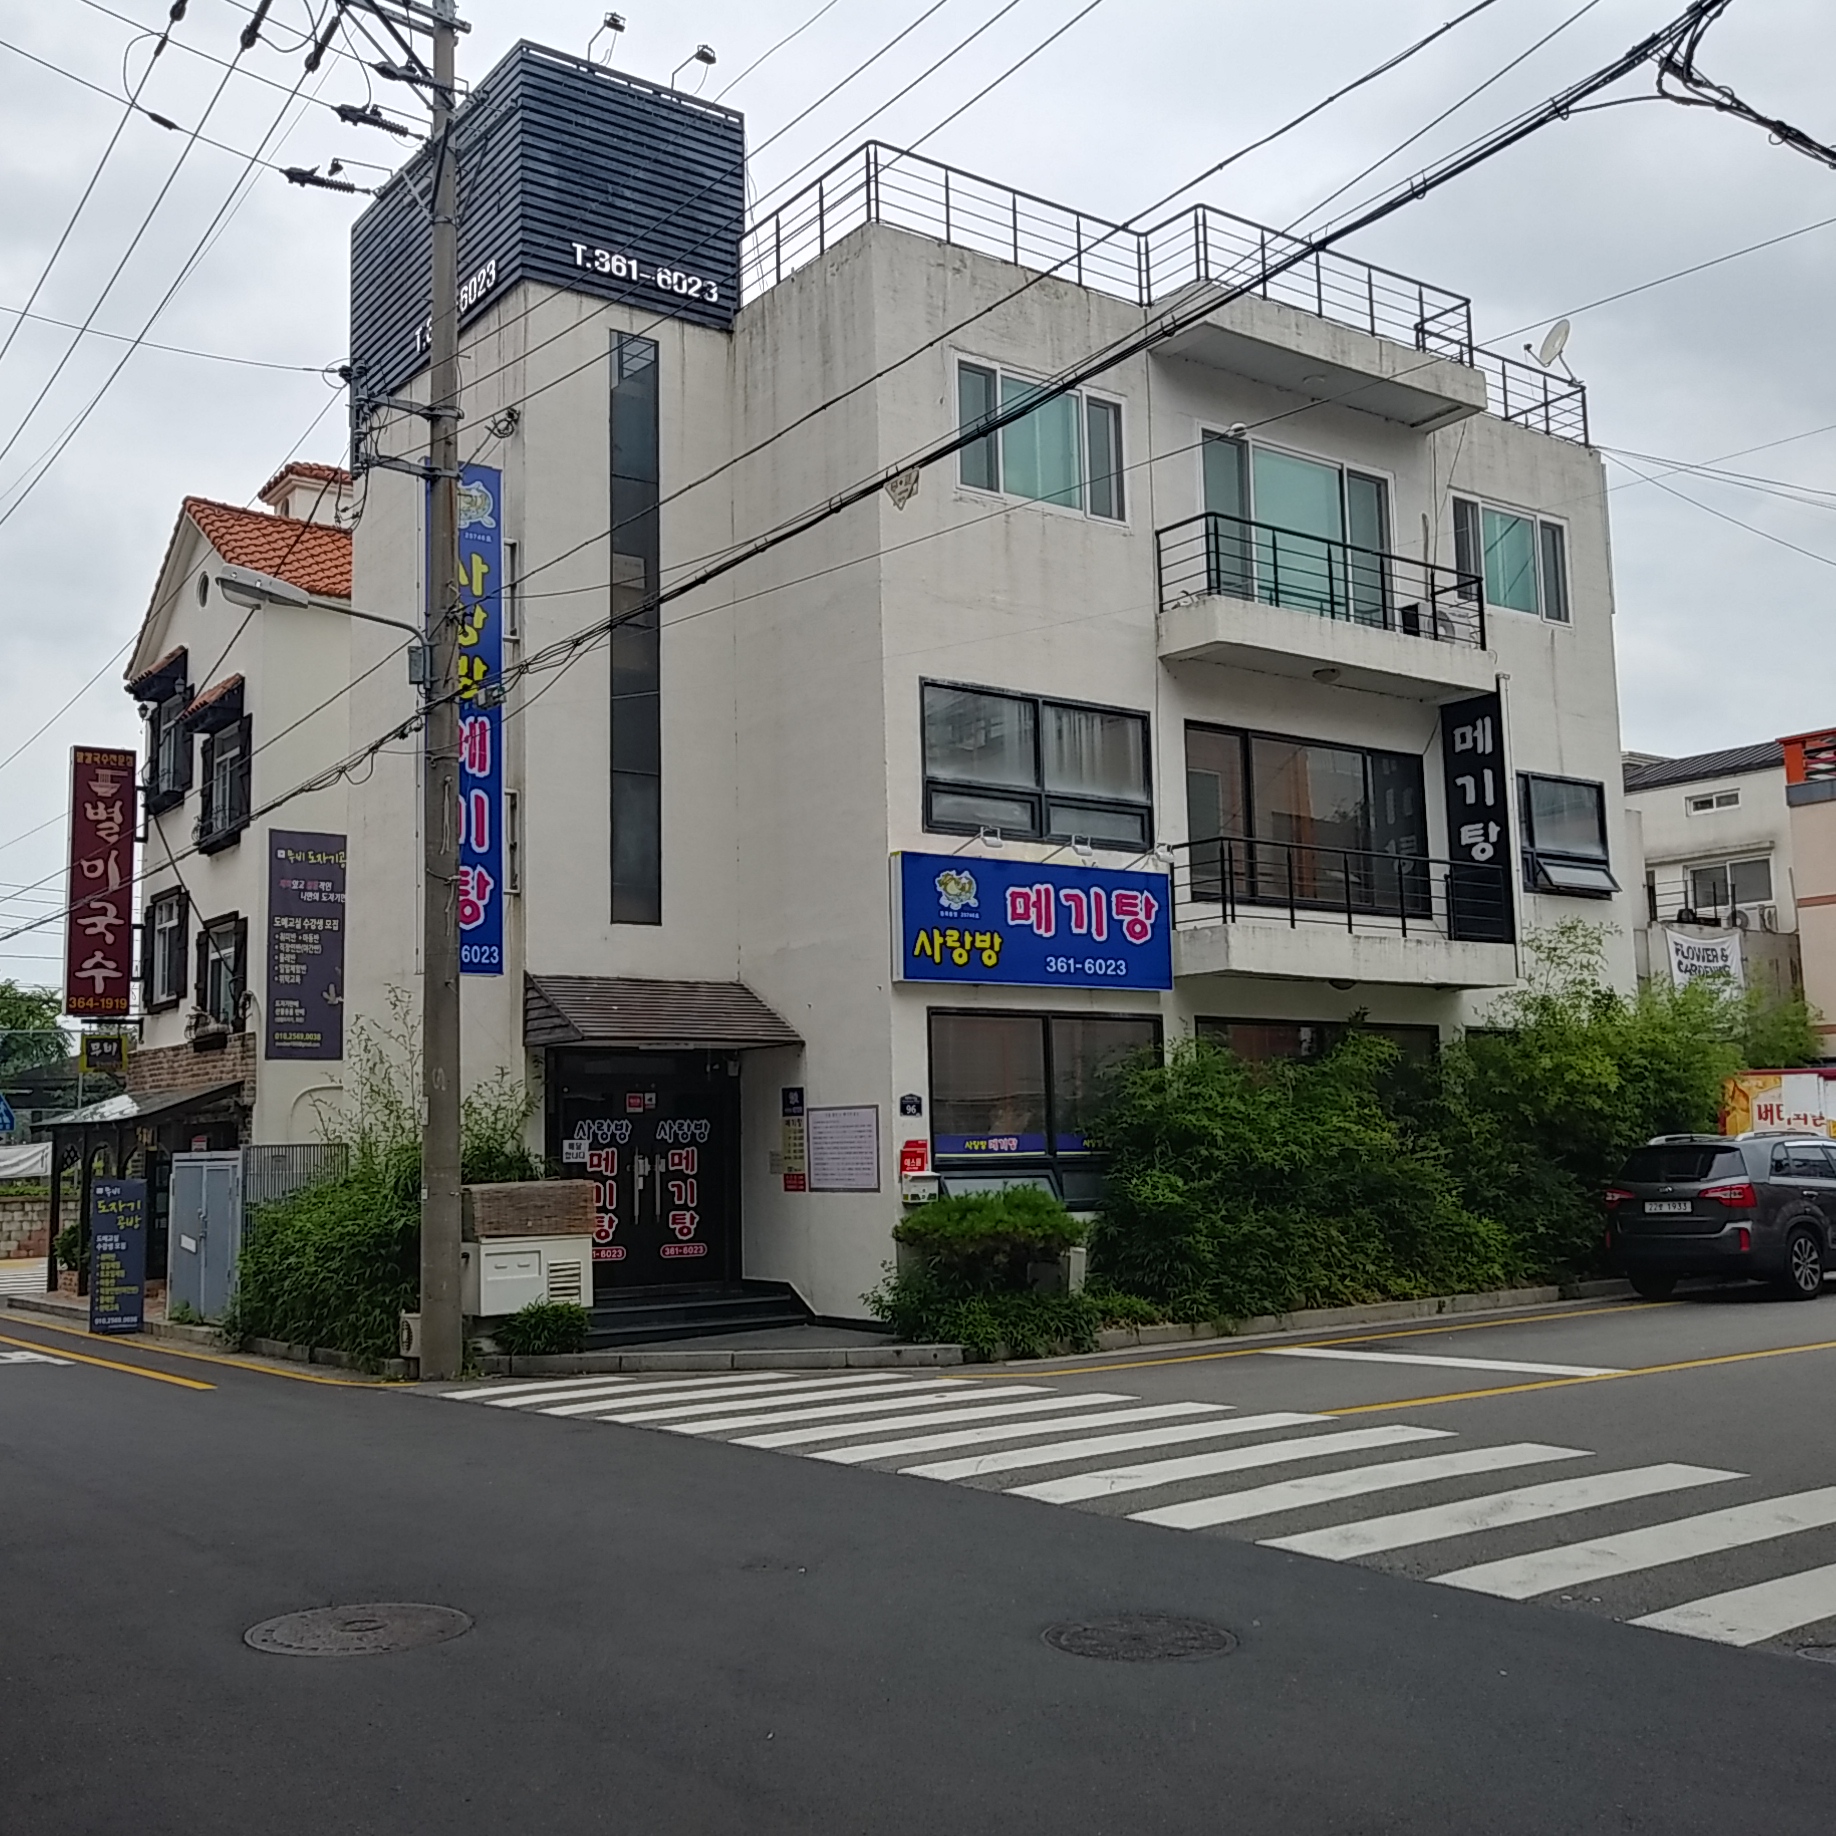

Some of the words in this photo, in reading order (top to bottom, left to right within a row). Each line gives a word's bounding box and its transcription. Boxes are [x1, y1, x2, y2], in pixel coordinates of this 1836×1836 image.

[571, 242, 718, 302] T.361-6023
[1453, 715, 1500, 861] 메기탕
[75, 799, 125, 995] 별미국수
[273, 916, 302, 929] 도예교실
[303, 918, 323, 930] 수강생
[325, 919, 339, 931] 모집
[1005, 883, 1159, 944] 메기탕
[913, 928, 1002, 967] 사랑방
[1673, 941, 1719, 963] FLOWER
[1720, 947, 1729, 962] &
[1046, 956, 1127, 976] 361-6023
[68, 997, 128, 1010] 364-1919
[89, 1041, 118, 1056] 무비
[905, 1104, 917, 1114] 96
[574, 1119, 632, 1144] 사랑방
[656, 1119, 710, 1143] 사랑방
[587, 1147, 618, 1243] 메기탕
[668, 1146, 700, 1240] 메기탕
[97, 1200, 141, 1213] 도자기
[116, 1215, 142, 1229] 공방
[592, 1250, 622, 1258] 1-6023
[665, 1246, 704, 1255] 361-6023
